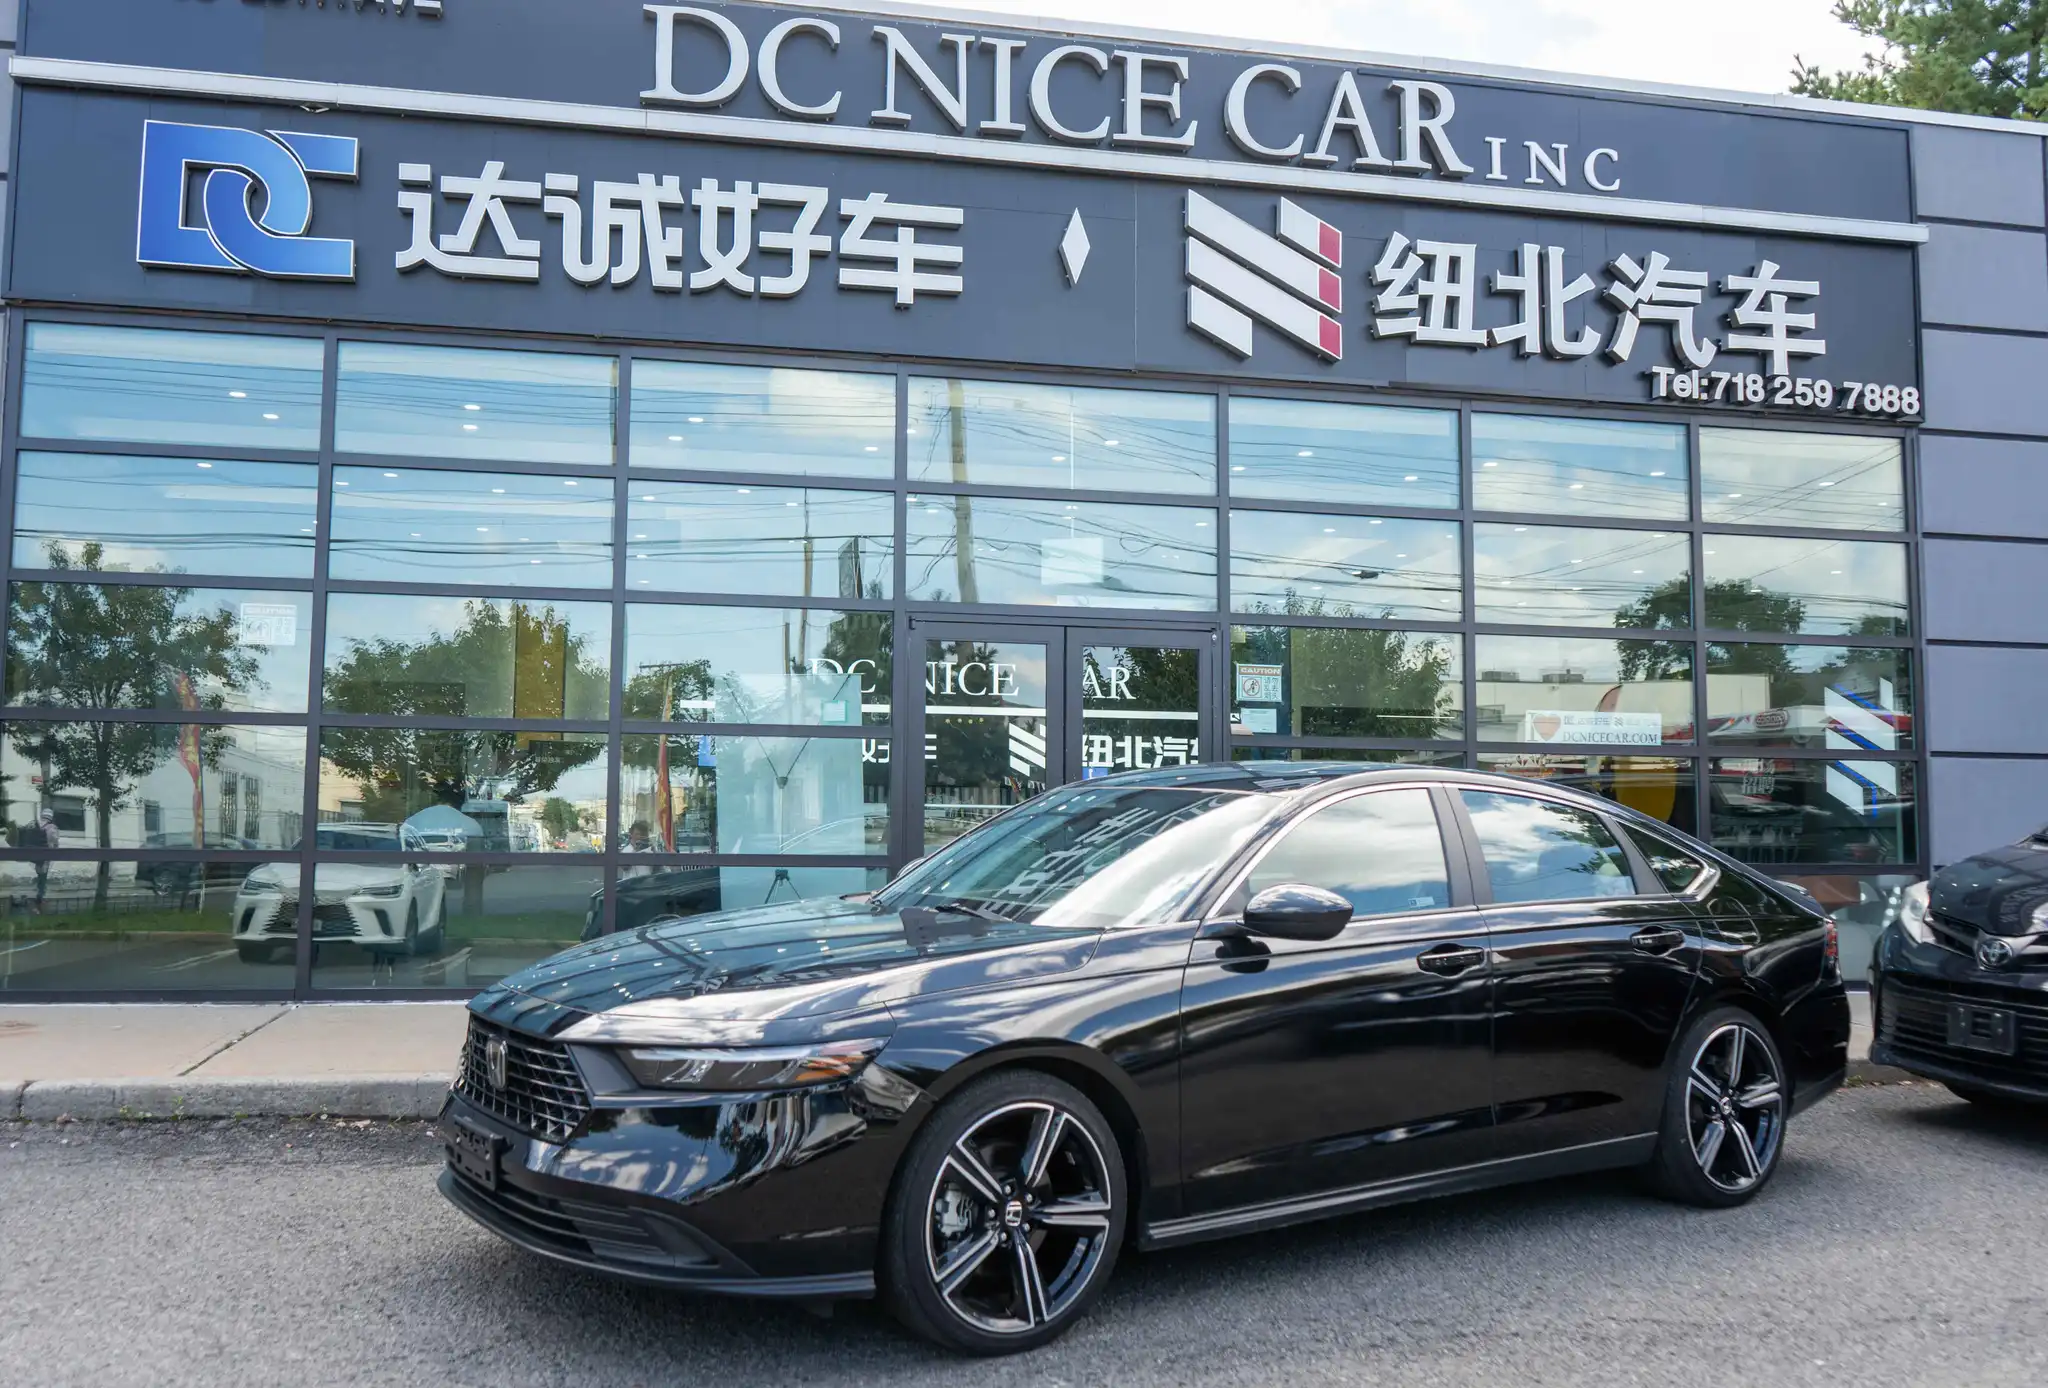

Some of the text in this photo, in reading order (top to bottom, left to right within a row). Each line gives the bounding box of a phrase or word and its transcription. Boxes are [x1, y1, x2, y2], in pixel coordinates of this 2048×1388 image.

[640, 3, 1621, 192] DC NICE CAR INC
[395, 160, 964, 308] 达诚好车
[1370, 230, 1826, 376] 纽北汽车
[1773, 375, 1833, 408] 259
[1842, 381, 1921, 415] 7888
[1240, 666, 1281, 675] CAUTION
[1563, 731, 1658, 744] DCNICECAR.COM
